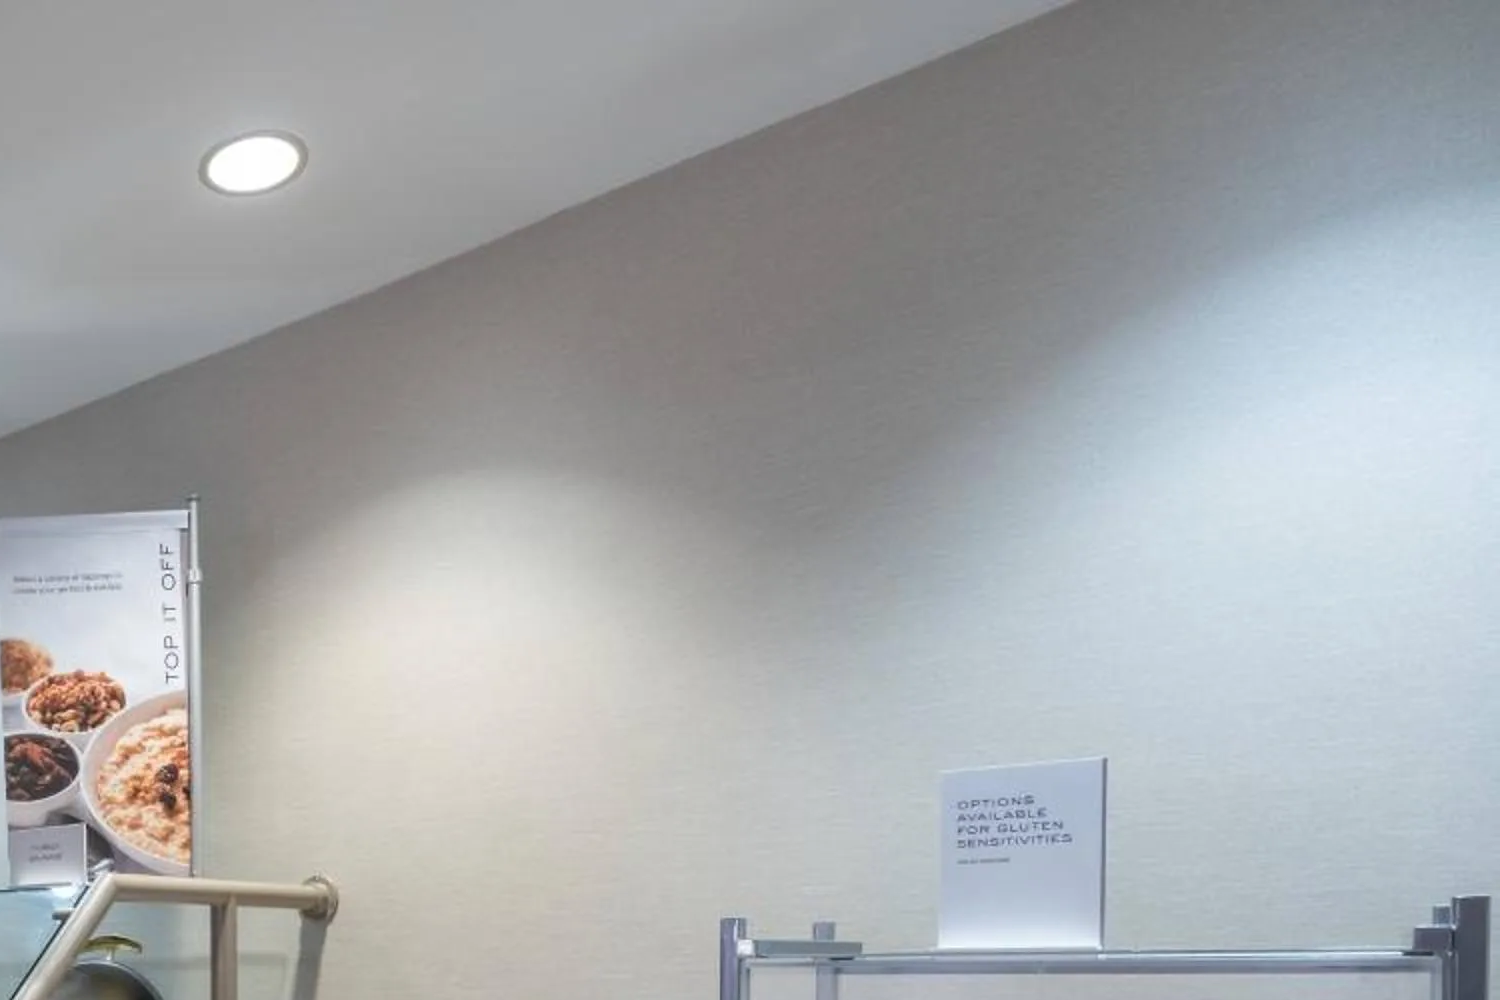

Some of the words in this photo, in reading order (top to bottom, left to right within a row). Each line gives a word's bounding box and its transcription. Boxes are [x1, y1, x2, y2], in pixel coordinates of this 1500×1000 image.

[159, 543, 177, 591] OFF
[162, 602, 177, 622] IT
[163, 635, 179, 684] TOP
[957, 795, 1034, 809] OPTIONS
[957, 808, 1047, 821] AVAILABLE
[957, 825, 990, 835] FOR
[997, 821, 1063, 833] GLUTEN
[957, 834, 1072, 848] SENSITIVITIES
